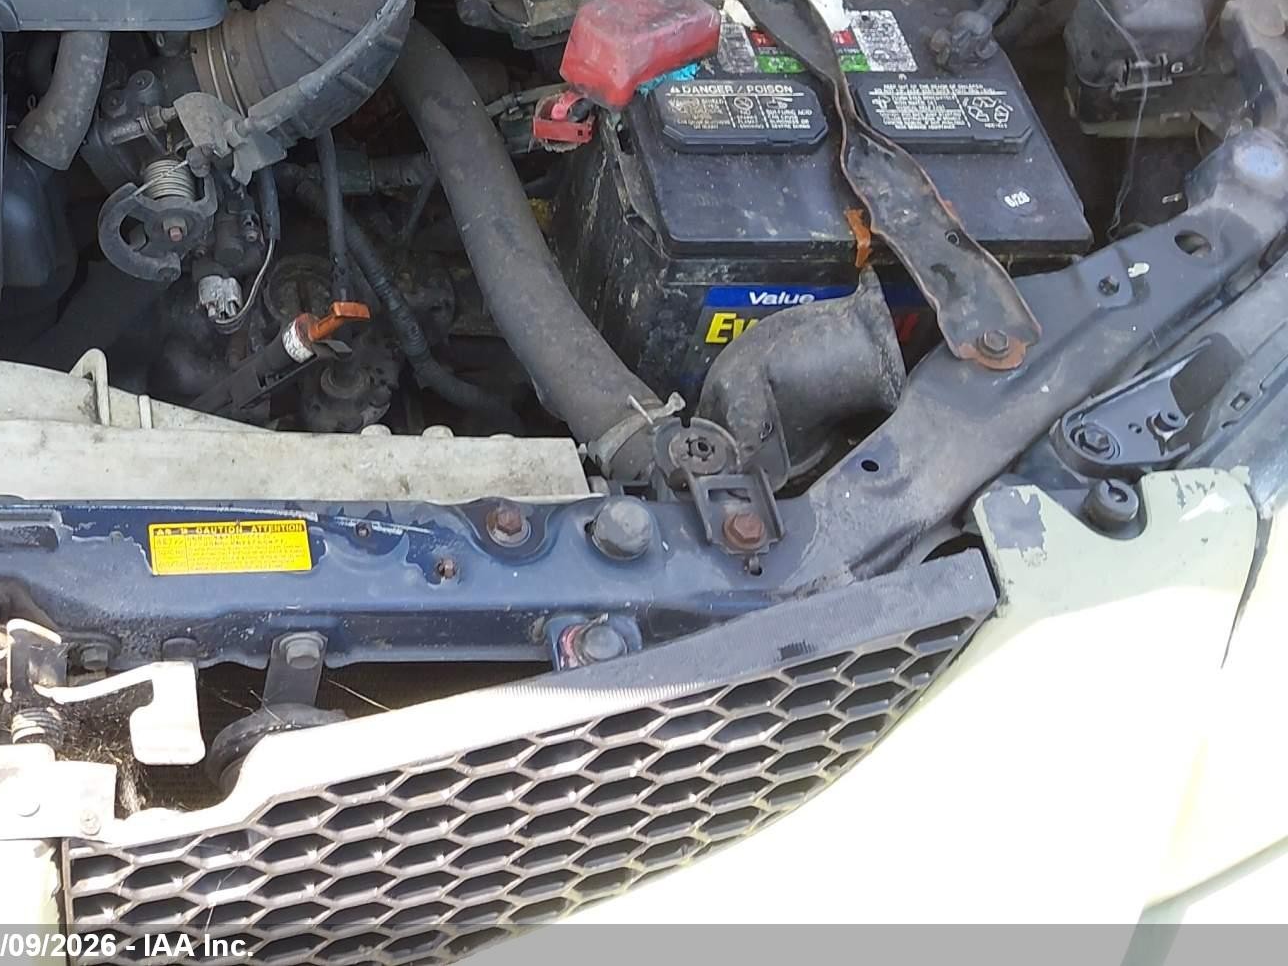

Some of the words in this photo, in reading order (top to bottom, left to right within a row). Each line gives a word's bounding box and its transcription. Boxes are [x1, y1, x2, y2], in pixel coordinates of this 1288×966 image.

[681, 85, 734, 95] DANGER
[746, 84, 793, 94] POISON
[748, 291, 816, 306] Value
[196, 525, 243, 535] CAUTION
[250, 523, 302, 534] ATTENTION
